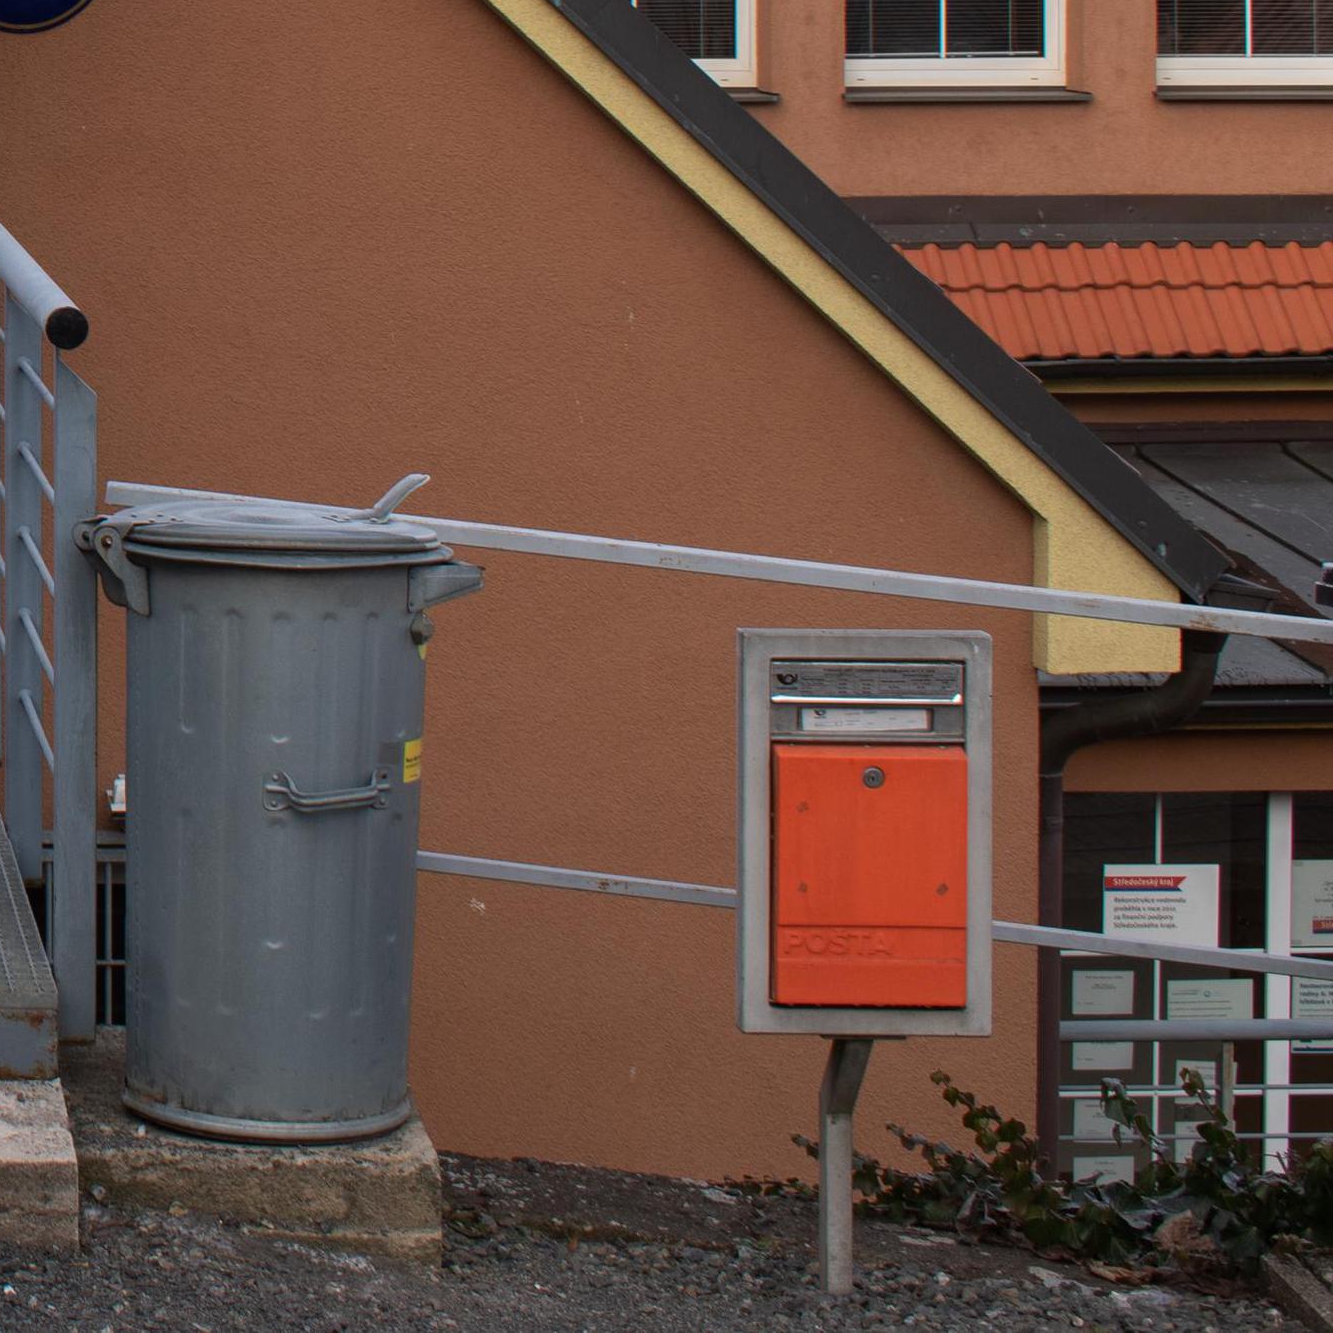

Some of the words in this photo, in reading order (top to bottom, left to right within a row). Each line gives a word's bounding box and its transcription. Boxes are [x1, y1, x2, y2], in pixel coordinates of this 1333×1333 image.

[1112, 877, 1159, 887] Středočeský
[1159, 877, 1174, 887] kraj
[783, 929, 893, 956] POŠTA
